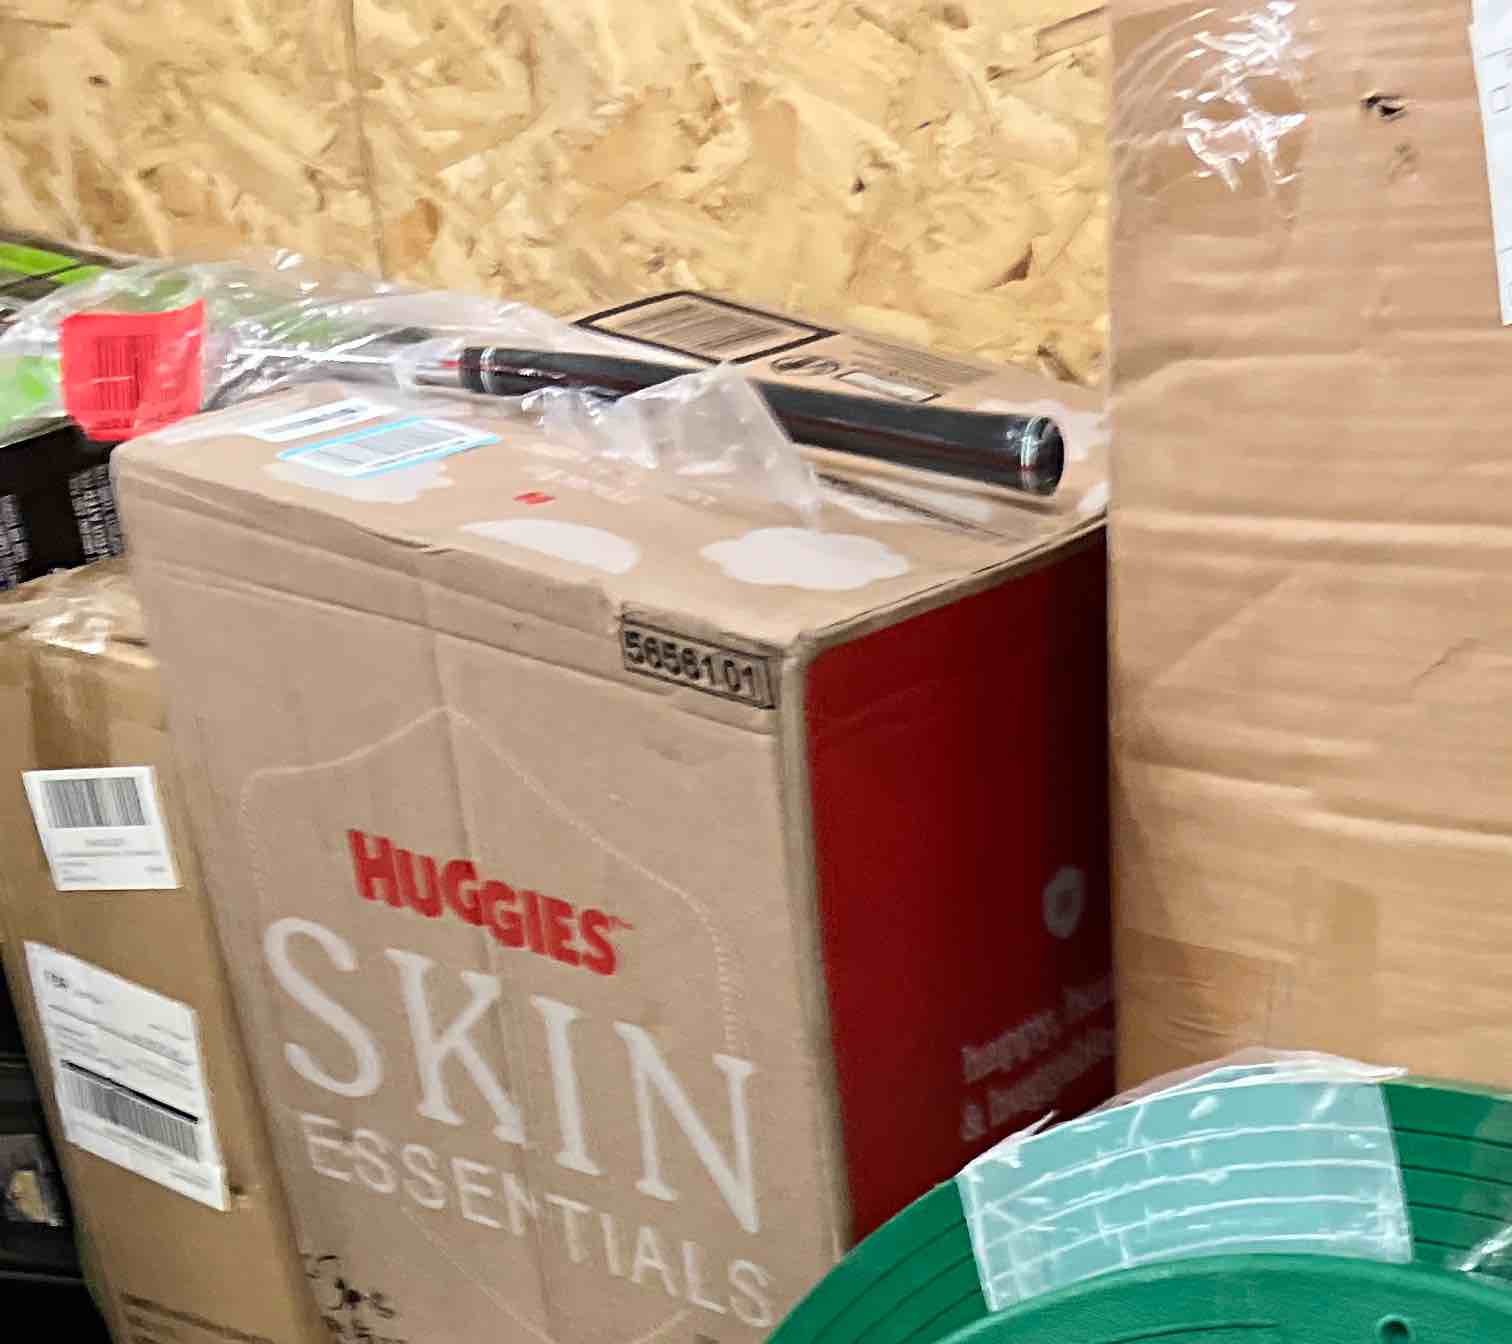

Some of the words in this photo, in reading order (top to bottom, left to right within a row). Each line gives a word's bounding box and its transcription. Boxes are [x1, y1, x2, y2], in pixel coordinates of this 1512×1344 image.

[347, 828, 622, 975] HUGGIES
[263, 917, 759, 1234] SKIN
[301, 1113, 774, 1328] ESSENTIALS
